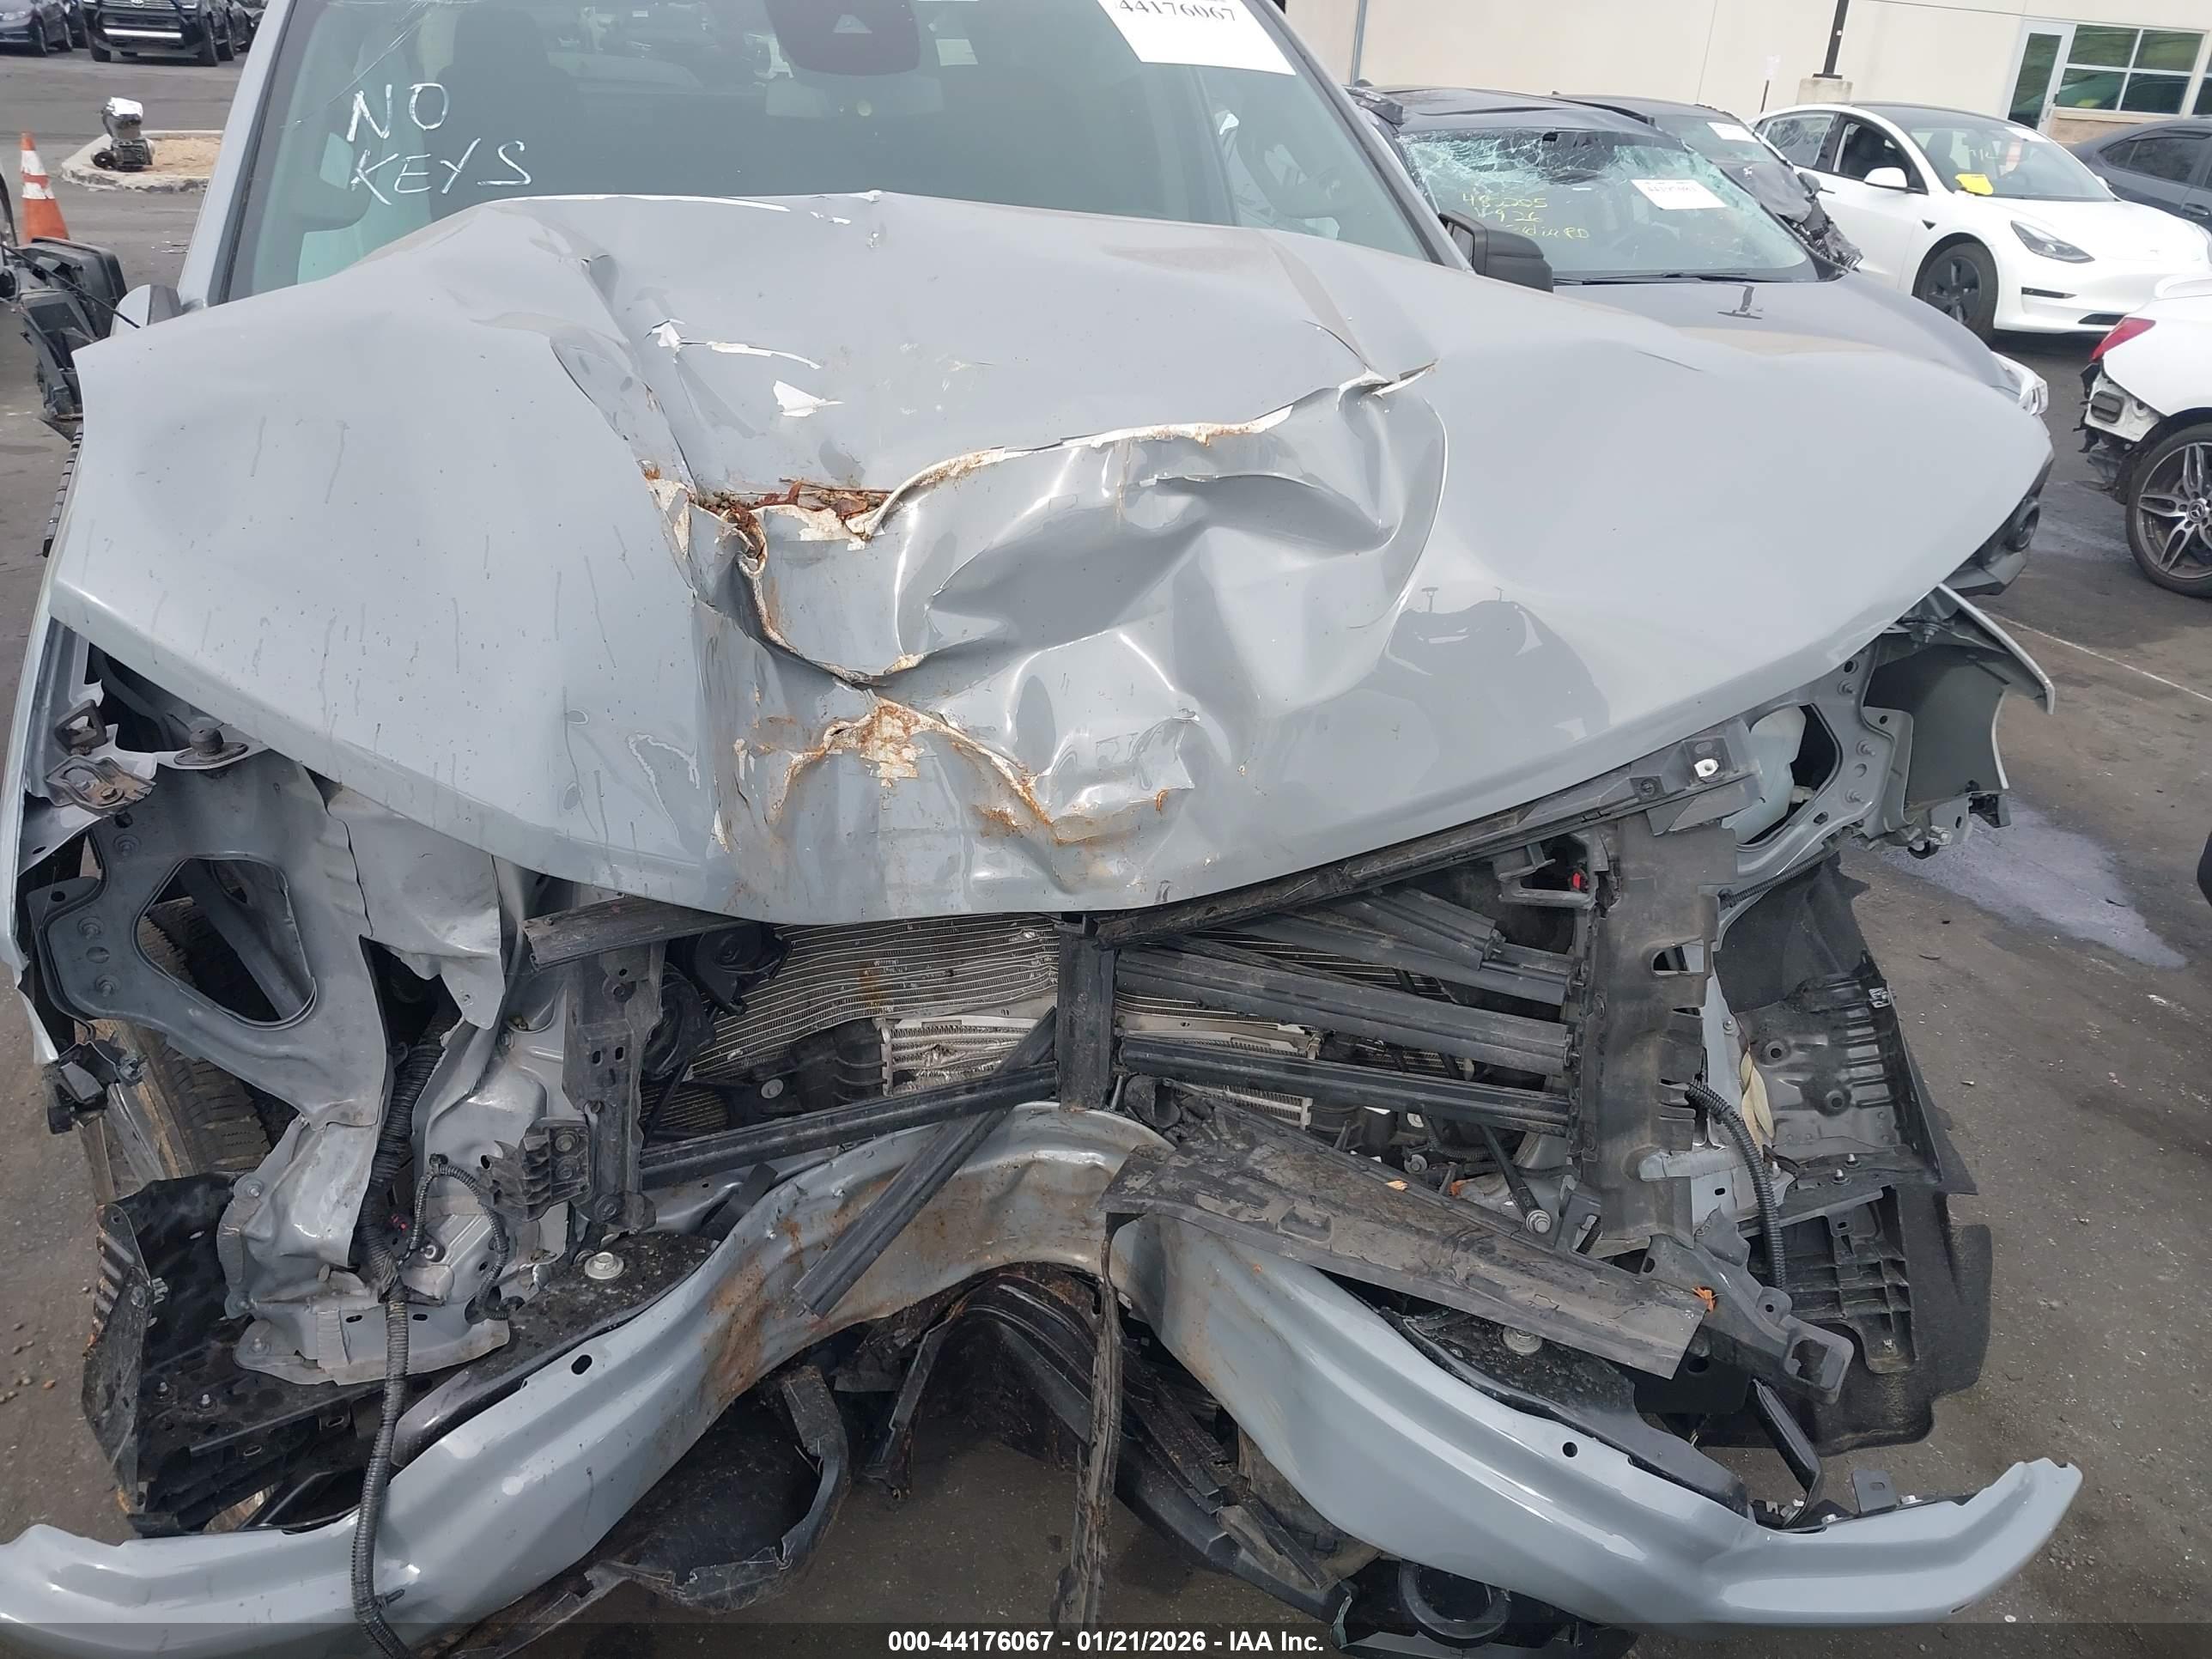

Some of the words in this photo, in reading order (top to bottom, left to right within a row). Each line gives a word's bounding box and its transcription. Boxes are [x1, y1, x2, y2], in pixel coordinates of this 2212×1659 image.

[1119, 0, 1236, 21] 44176067
[346, 82, 450, 142] NO
[350, 137, 532, 206] KEYS
